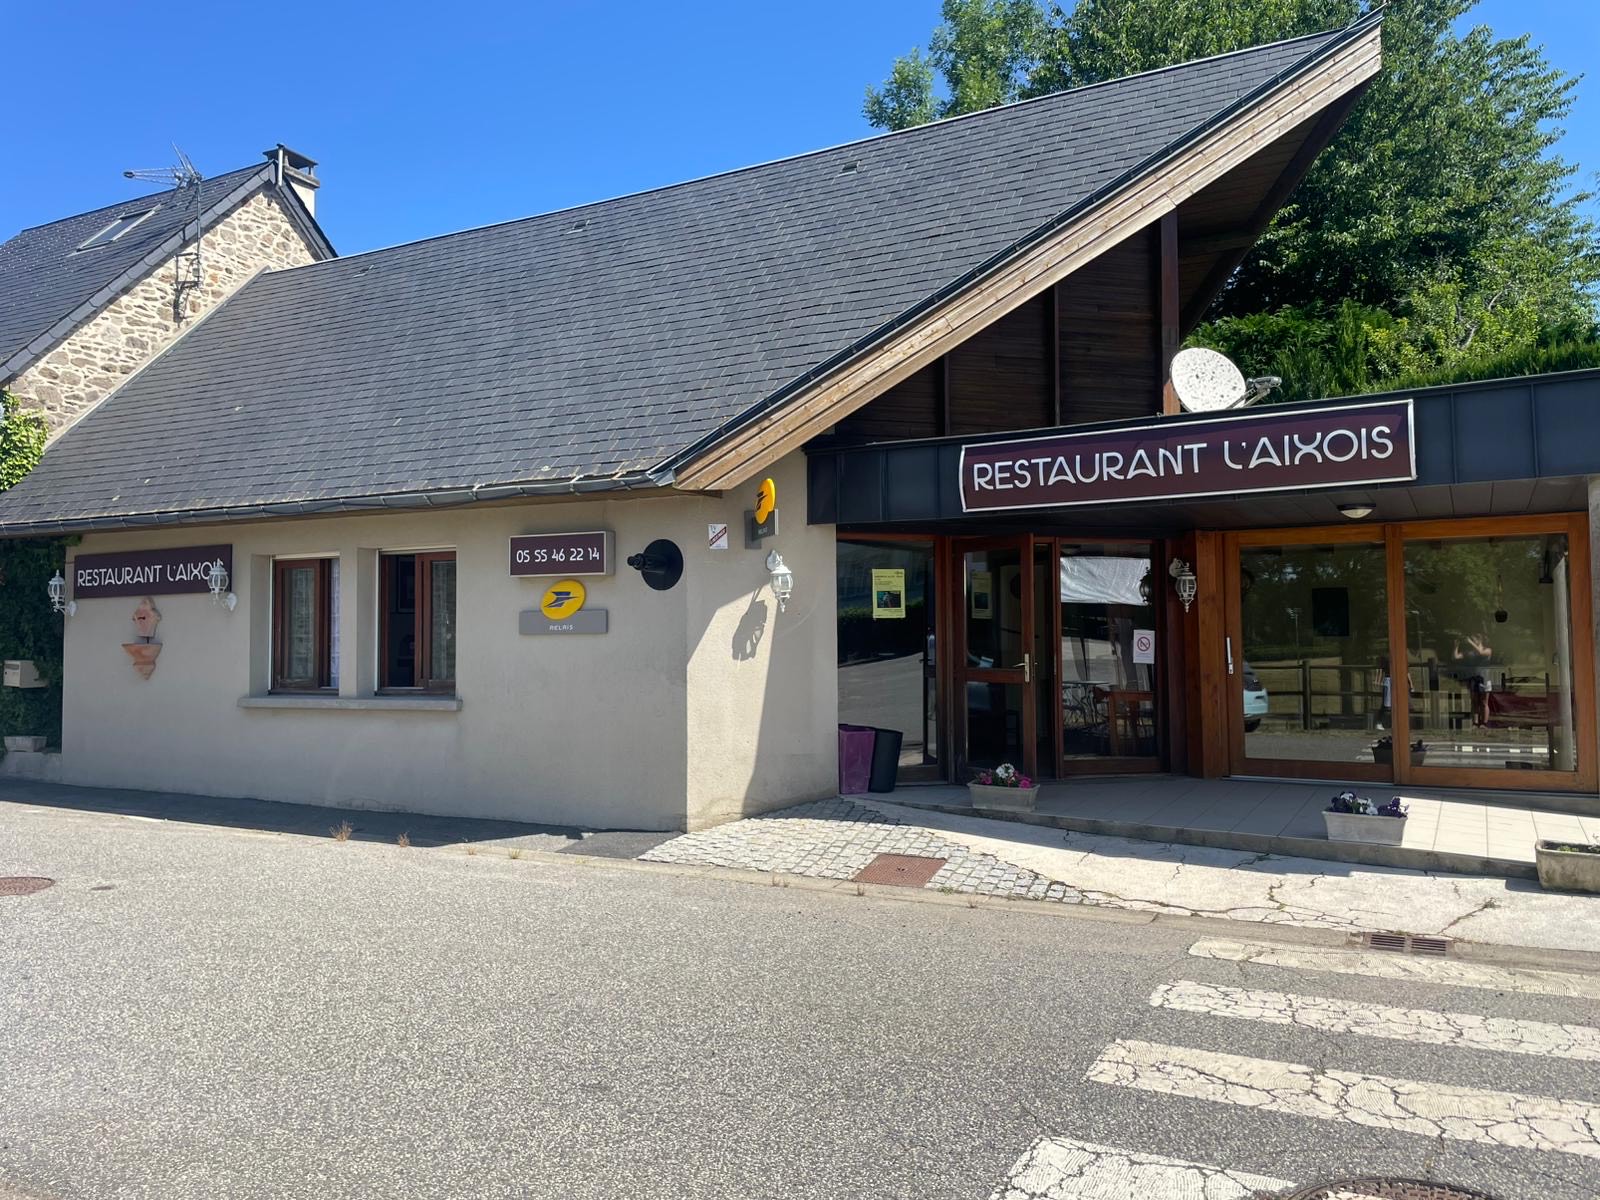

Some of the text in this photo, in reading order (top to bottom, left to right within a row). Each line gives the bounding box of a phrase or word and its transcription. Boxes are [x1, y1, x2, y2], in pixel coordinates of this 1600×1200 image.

[973, 425, 1394, 491] RESTAURANT L'AIXOIS
[516, 547, 600, 563] 05 55 46 22 14
[77, 561, 224, 587] RESTAURANT L'AIXO
